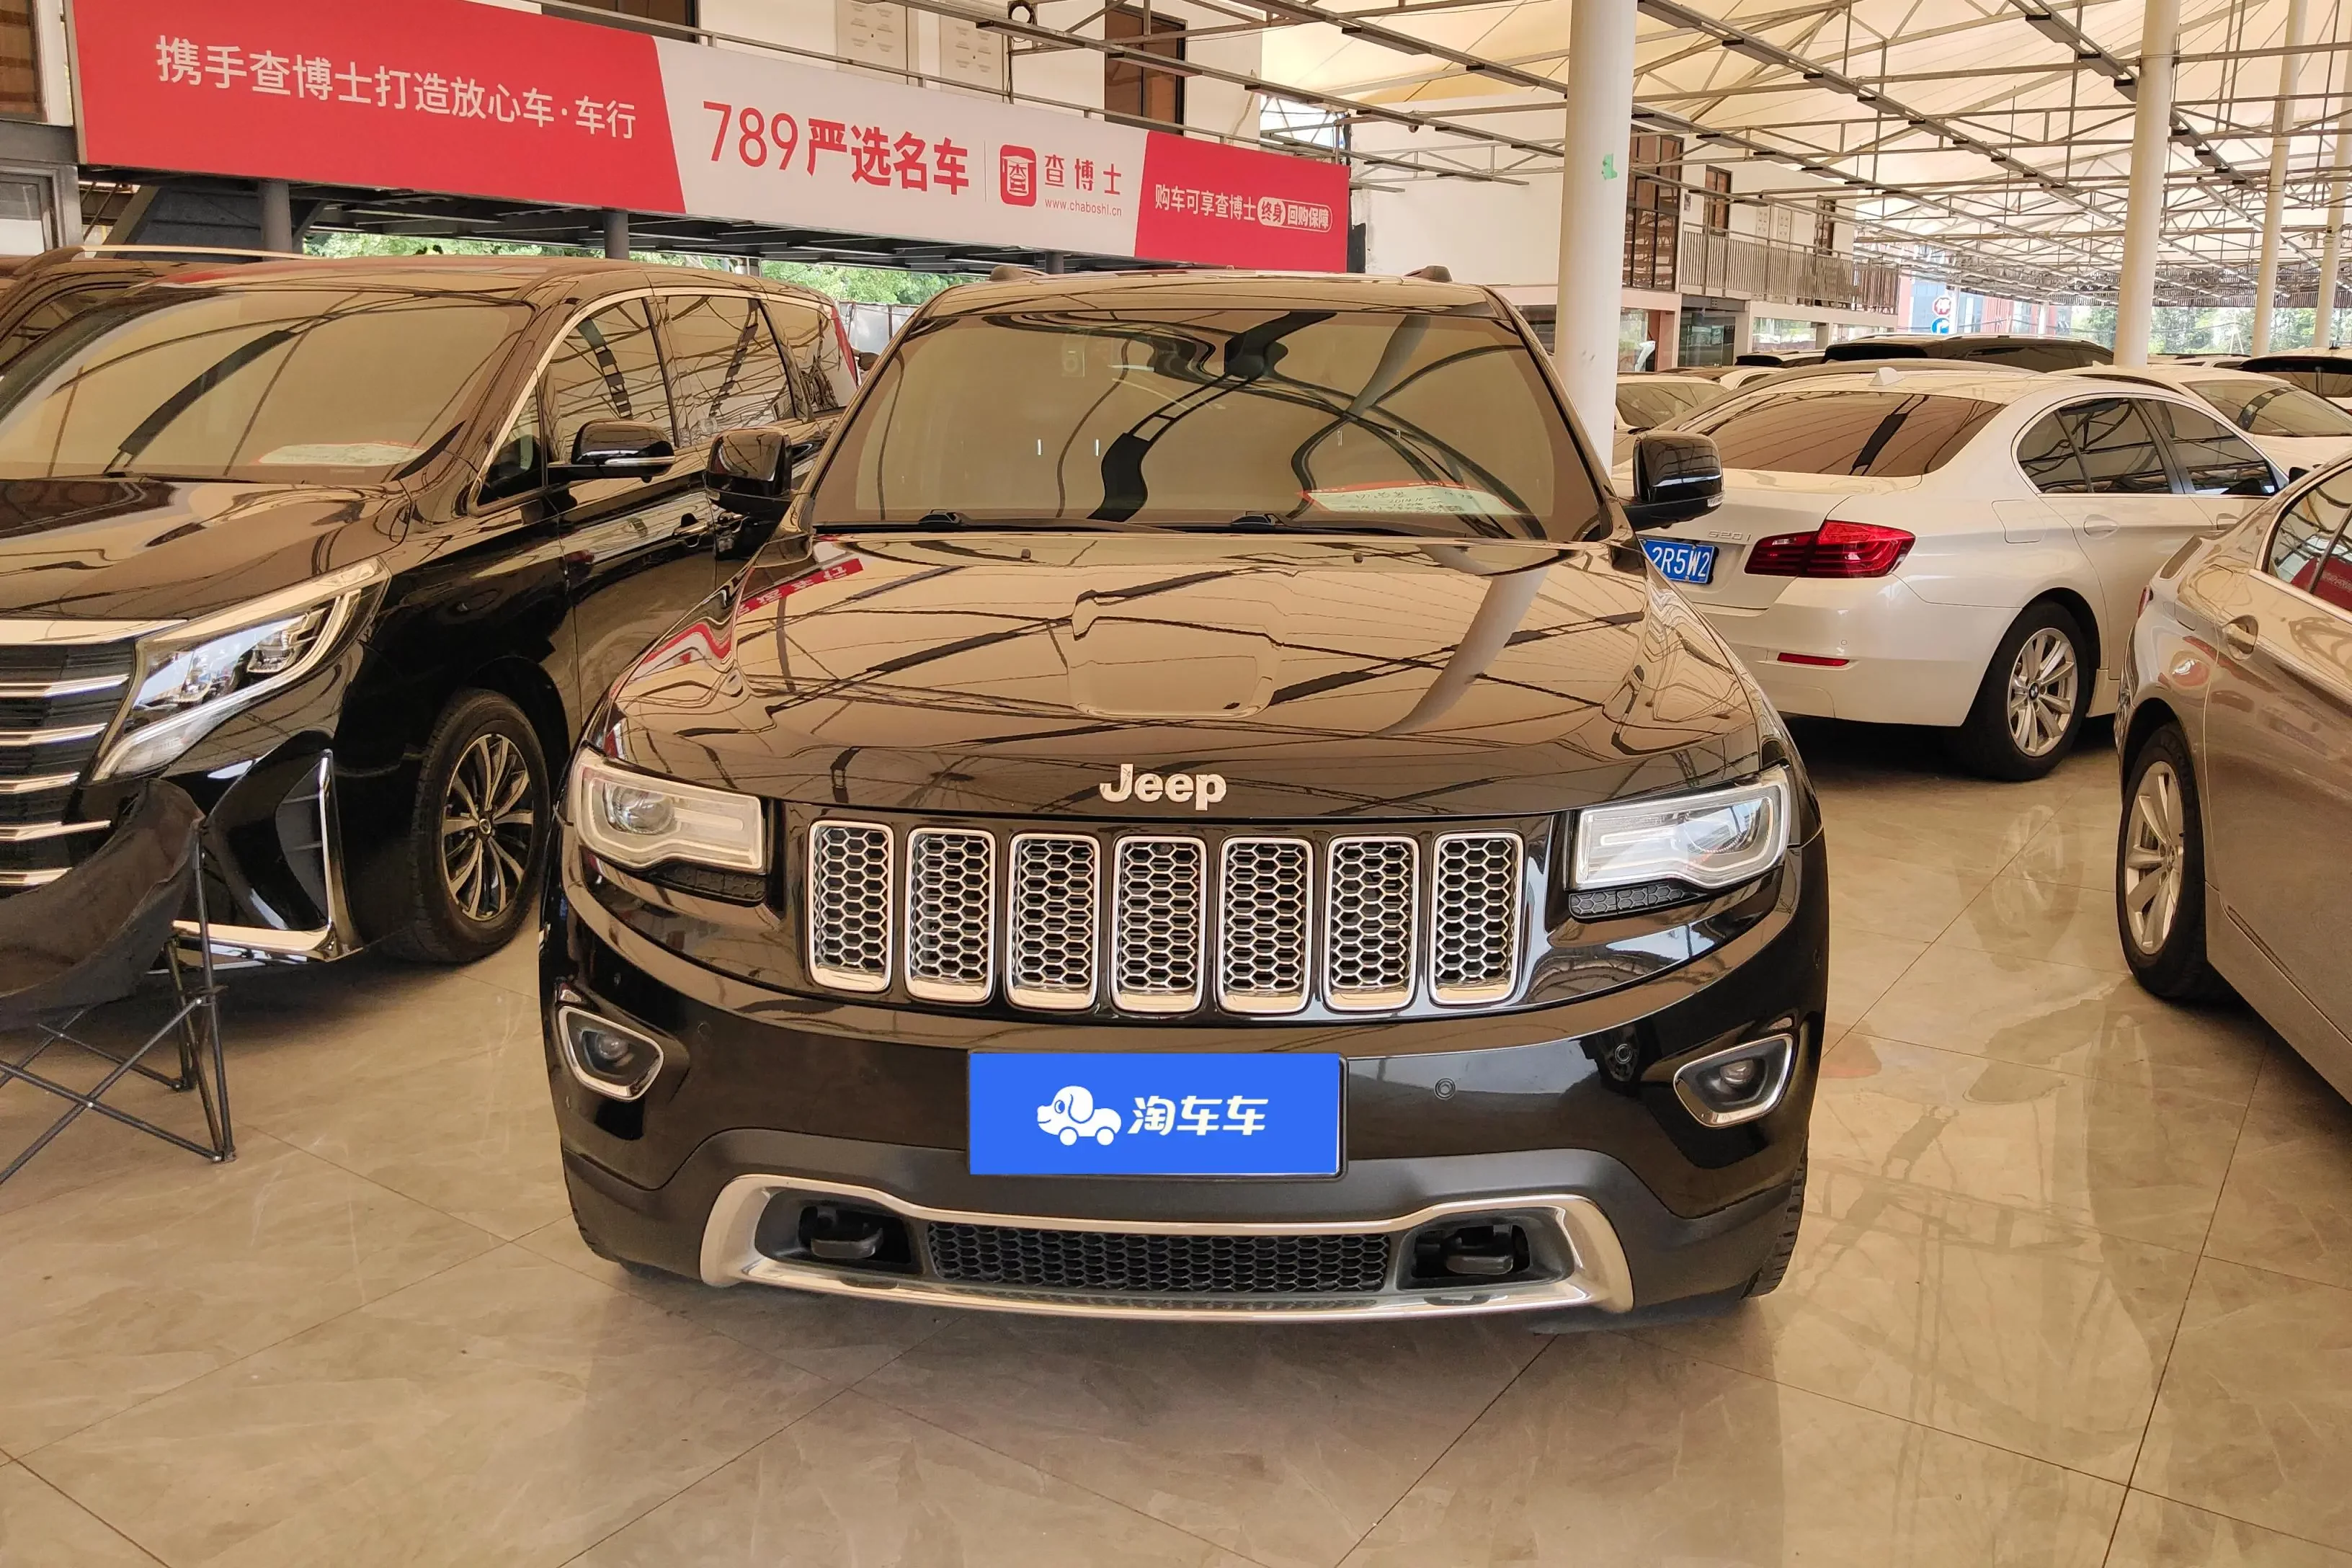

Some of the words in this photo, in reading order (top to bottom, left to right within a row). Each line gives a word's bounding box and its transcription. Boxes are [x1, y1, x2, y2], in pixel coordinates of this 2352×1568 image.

[156, 35, 636, 139] 携手查博士打造放心车·车行
[703, 100, 969, 195] 789严选名车
[1045, 153, 1122, 195] 查博士
[1099, 763, 1227, 811] Jeep
